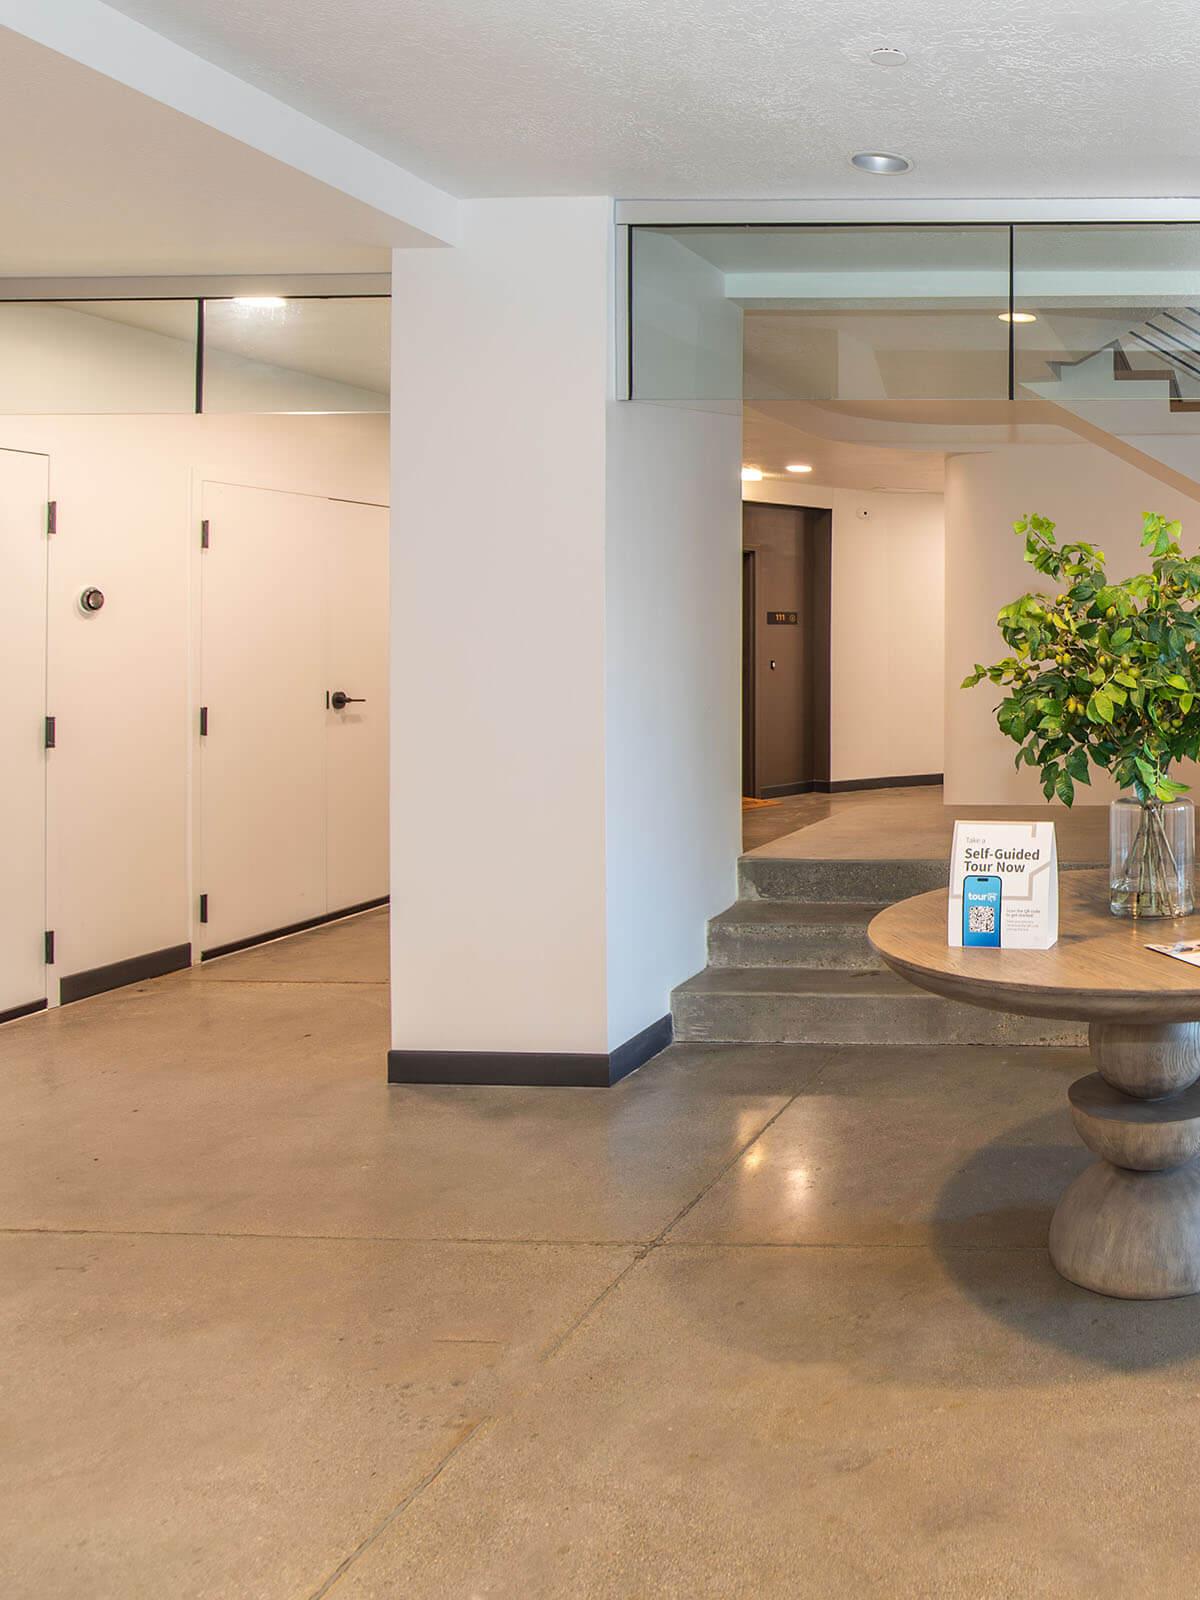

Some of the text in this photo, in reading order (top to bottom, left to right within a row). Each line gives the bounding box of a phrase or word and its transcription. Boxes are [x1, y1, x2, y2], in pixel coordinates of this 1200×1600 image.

[964, 847, 1040, 860] Self-Guided
[963, 860, 1025, 873] Tour Now
